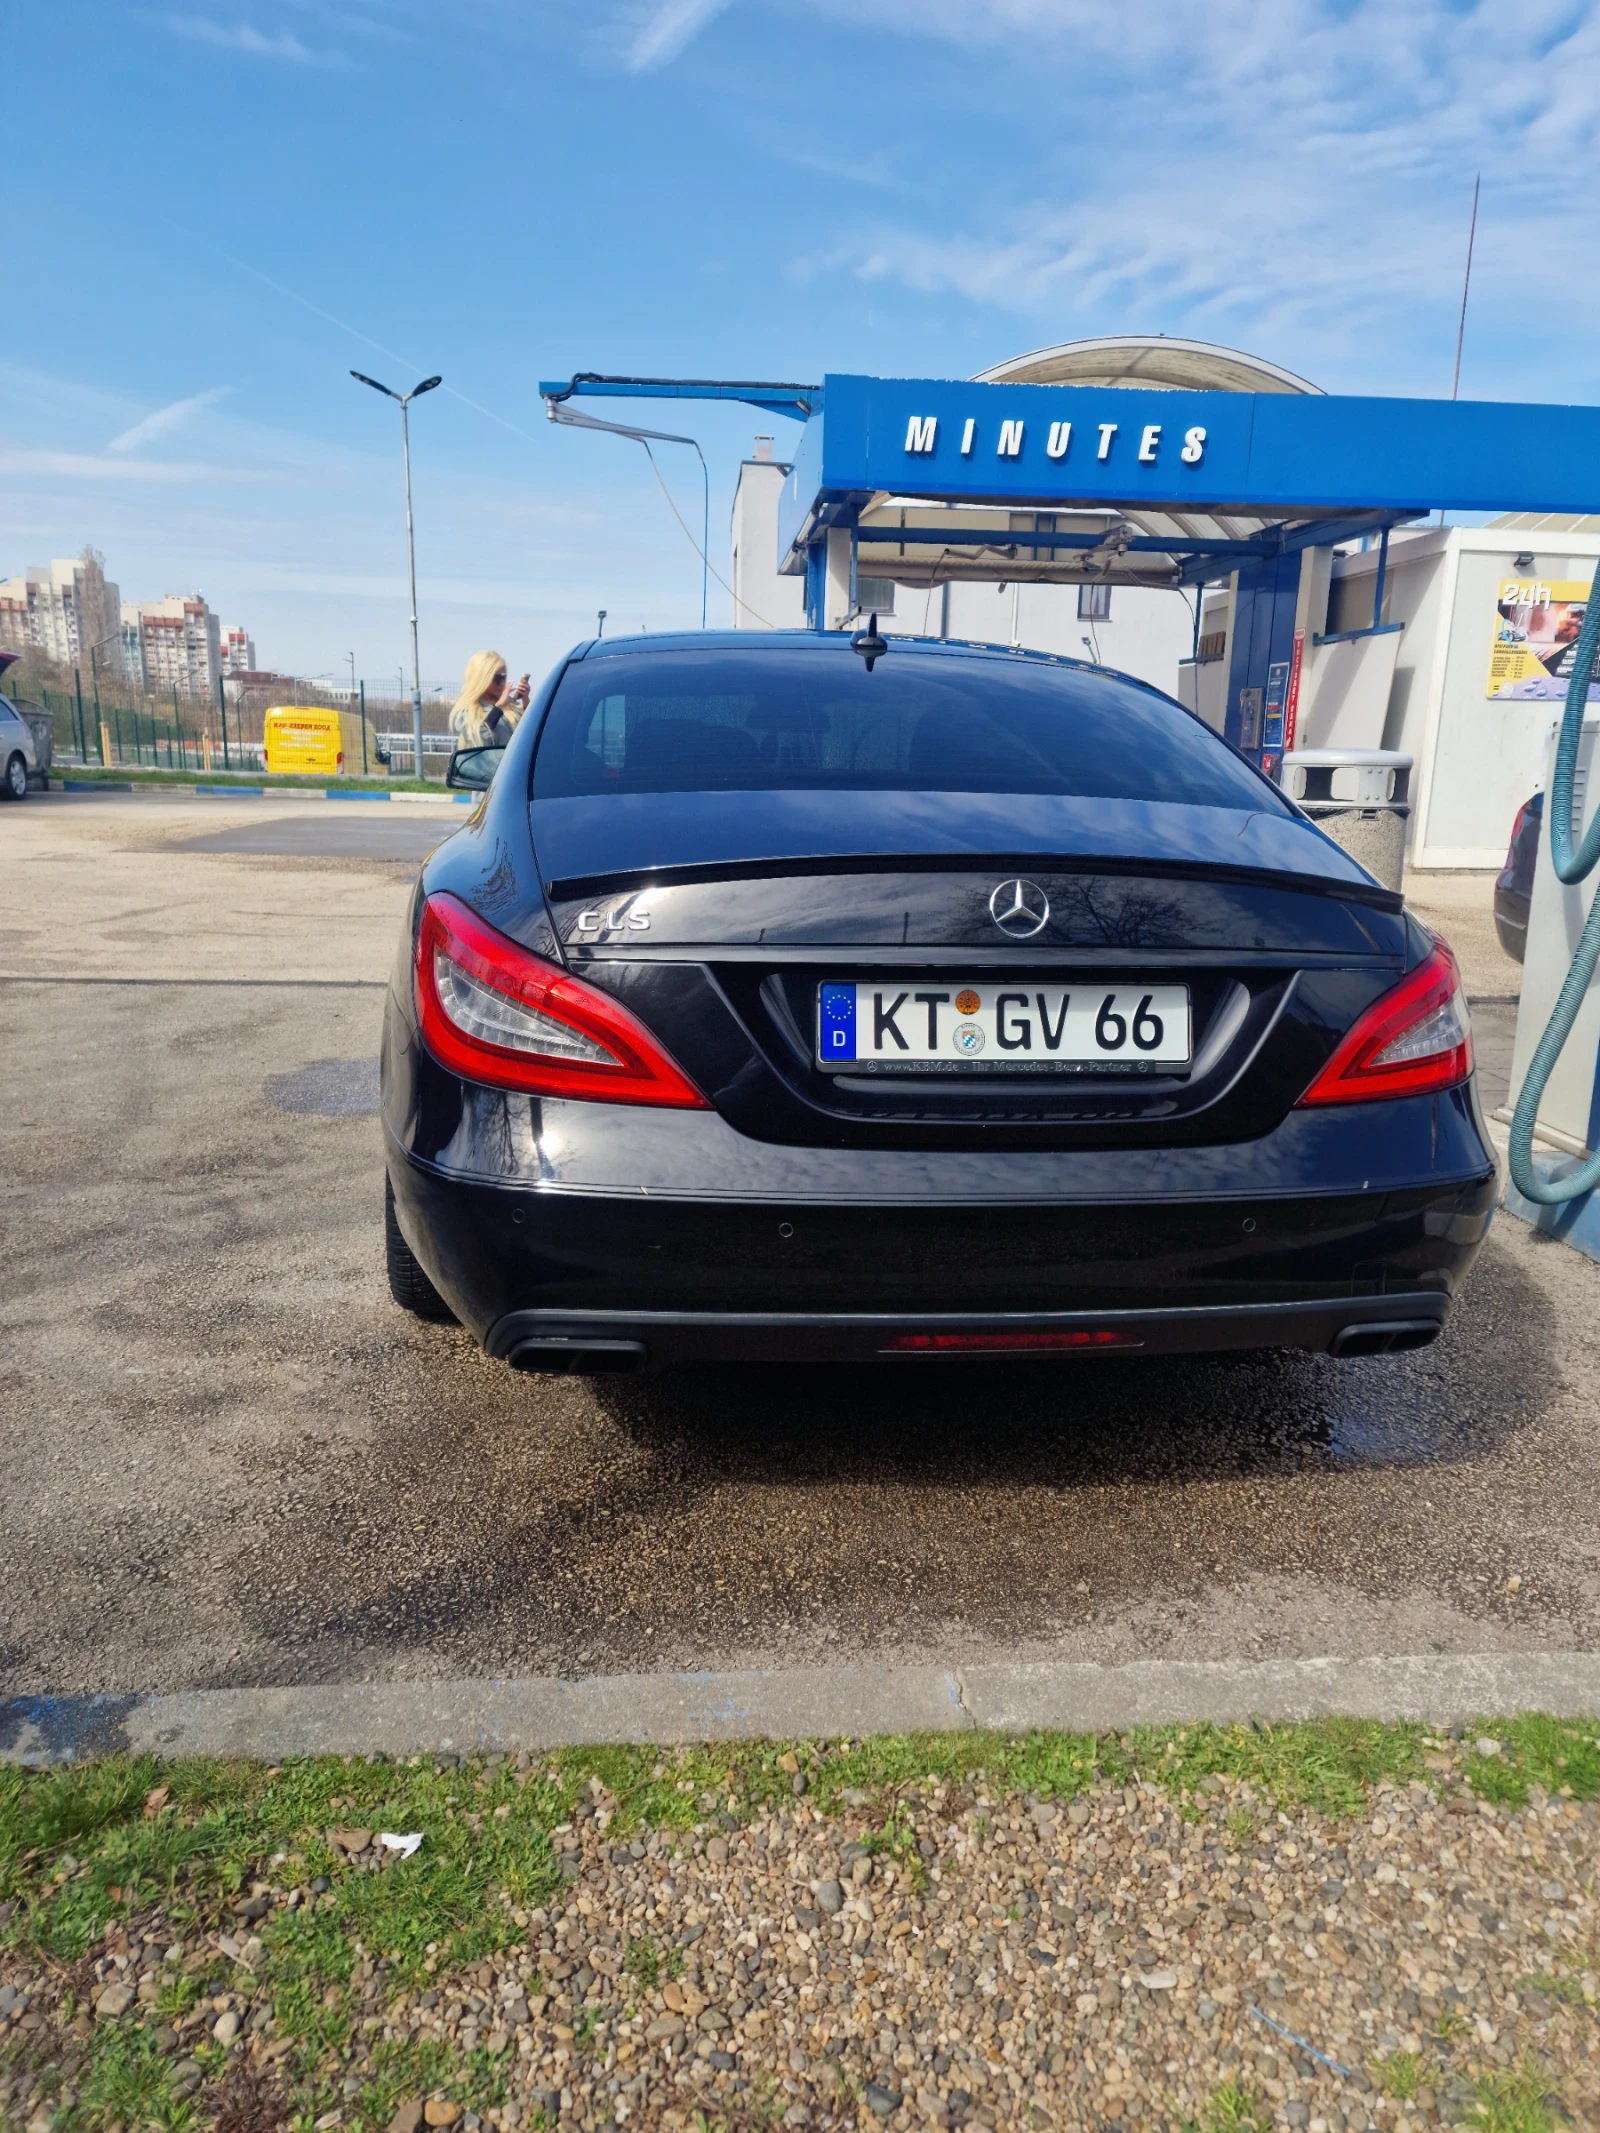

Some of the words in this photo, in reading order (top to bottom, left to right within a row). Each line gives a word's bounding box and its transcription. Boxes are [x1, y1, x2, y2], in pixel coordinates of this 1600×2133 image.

[904, 415, 1208, 463] MINUTES
[1502, 581, 1552, 611] 24h
[577, 910, 651, 932] CLS
[874, 992, 950, 1050] KT
[996, 993, 1071, 1051] GV
[1095, 993, 1164, 1051] 66
[833, 1030, 846, 1047] D
[884, 1061, 958, 1072] www.KBM.de
[972, 1061, 990, 1072] Ihr
